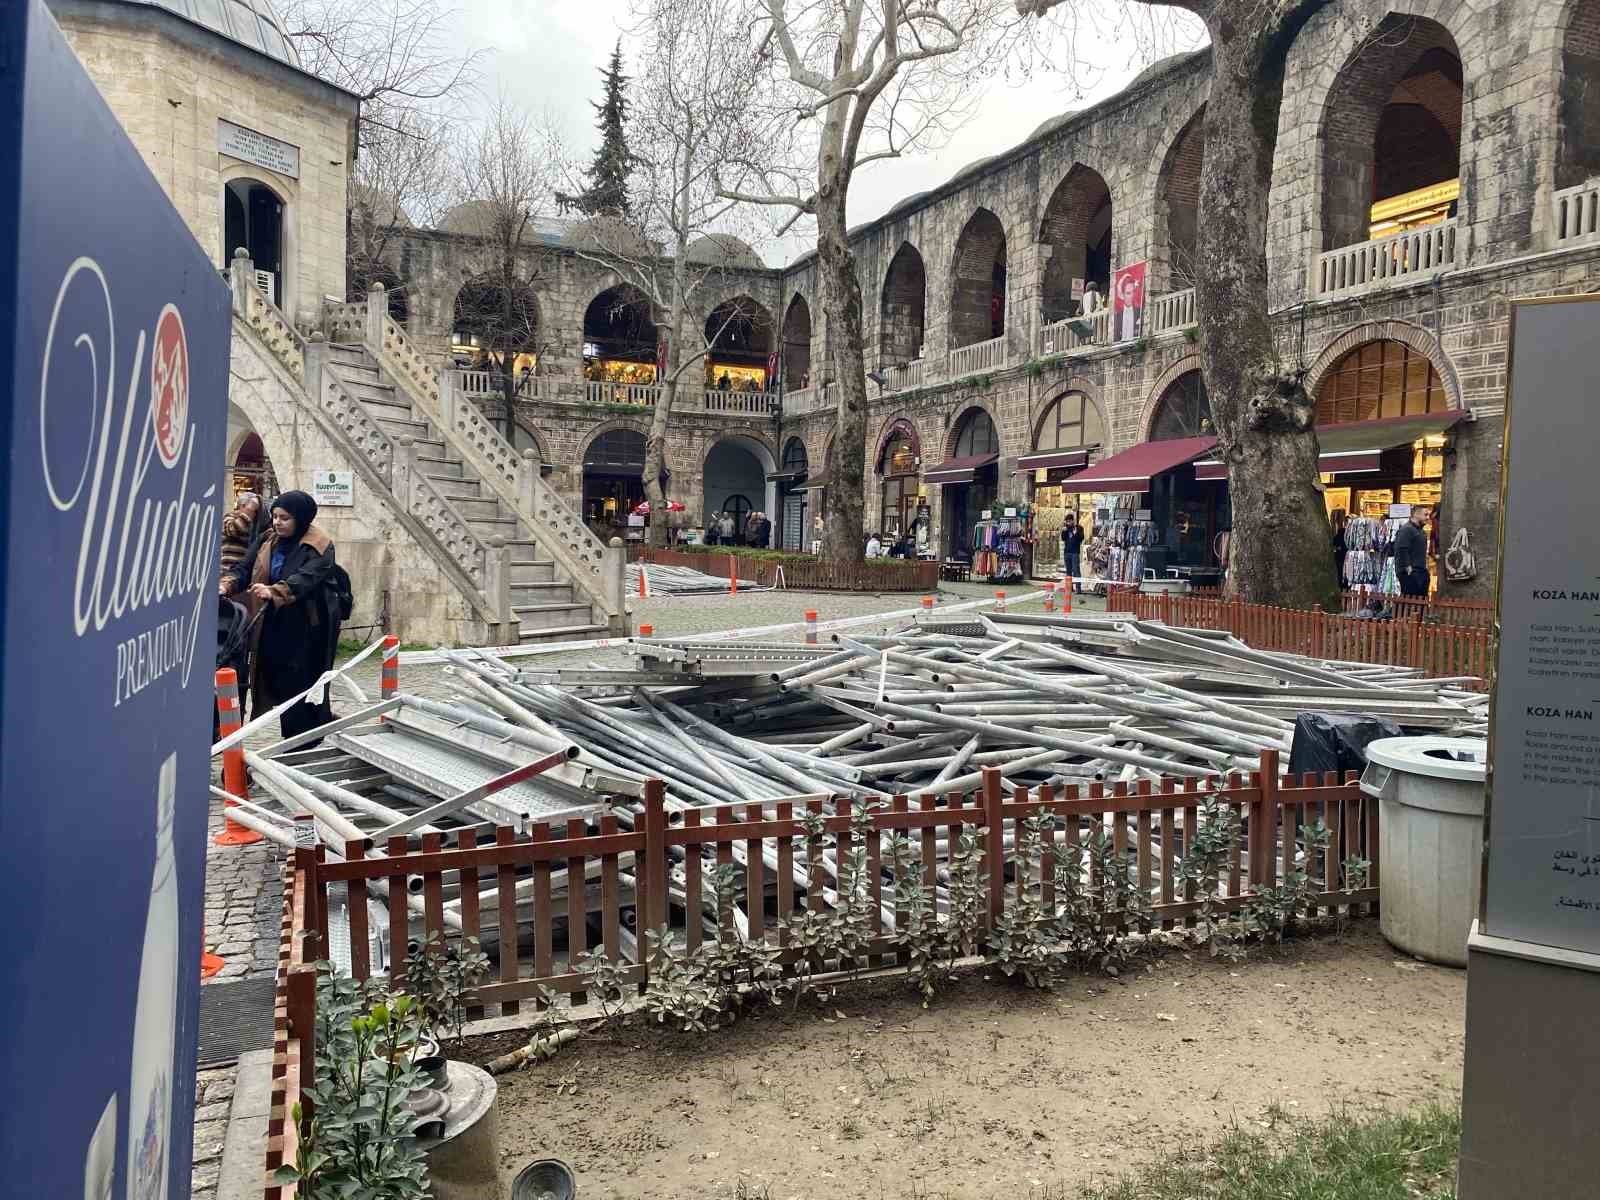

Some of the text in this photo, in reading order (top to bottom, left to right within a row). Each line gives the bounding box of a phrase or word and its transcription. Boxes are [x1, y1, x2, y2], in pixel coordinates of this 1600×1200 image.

[1533, 590, 1600, 601] KOZA HAN
[1526, 707, 1593, 720] KOZA HAN
